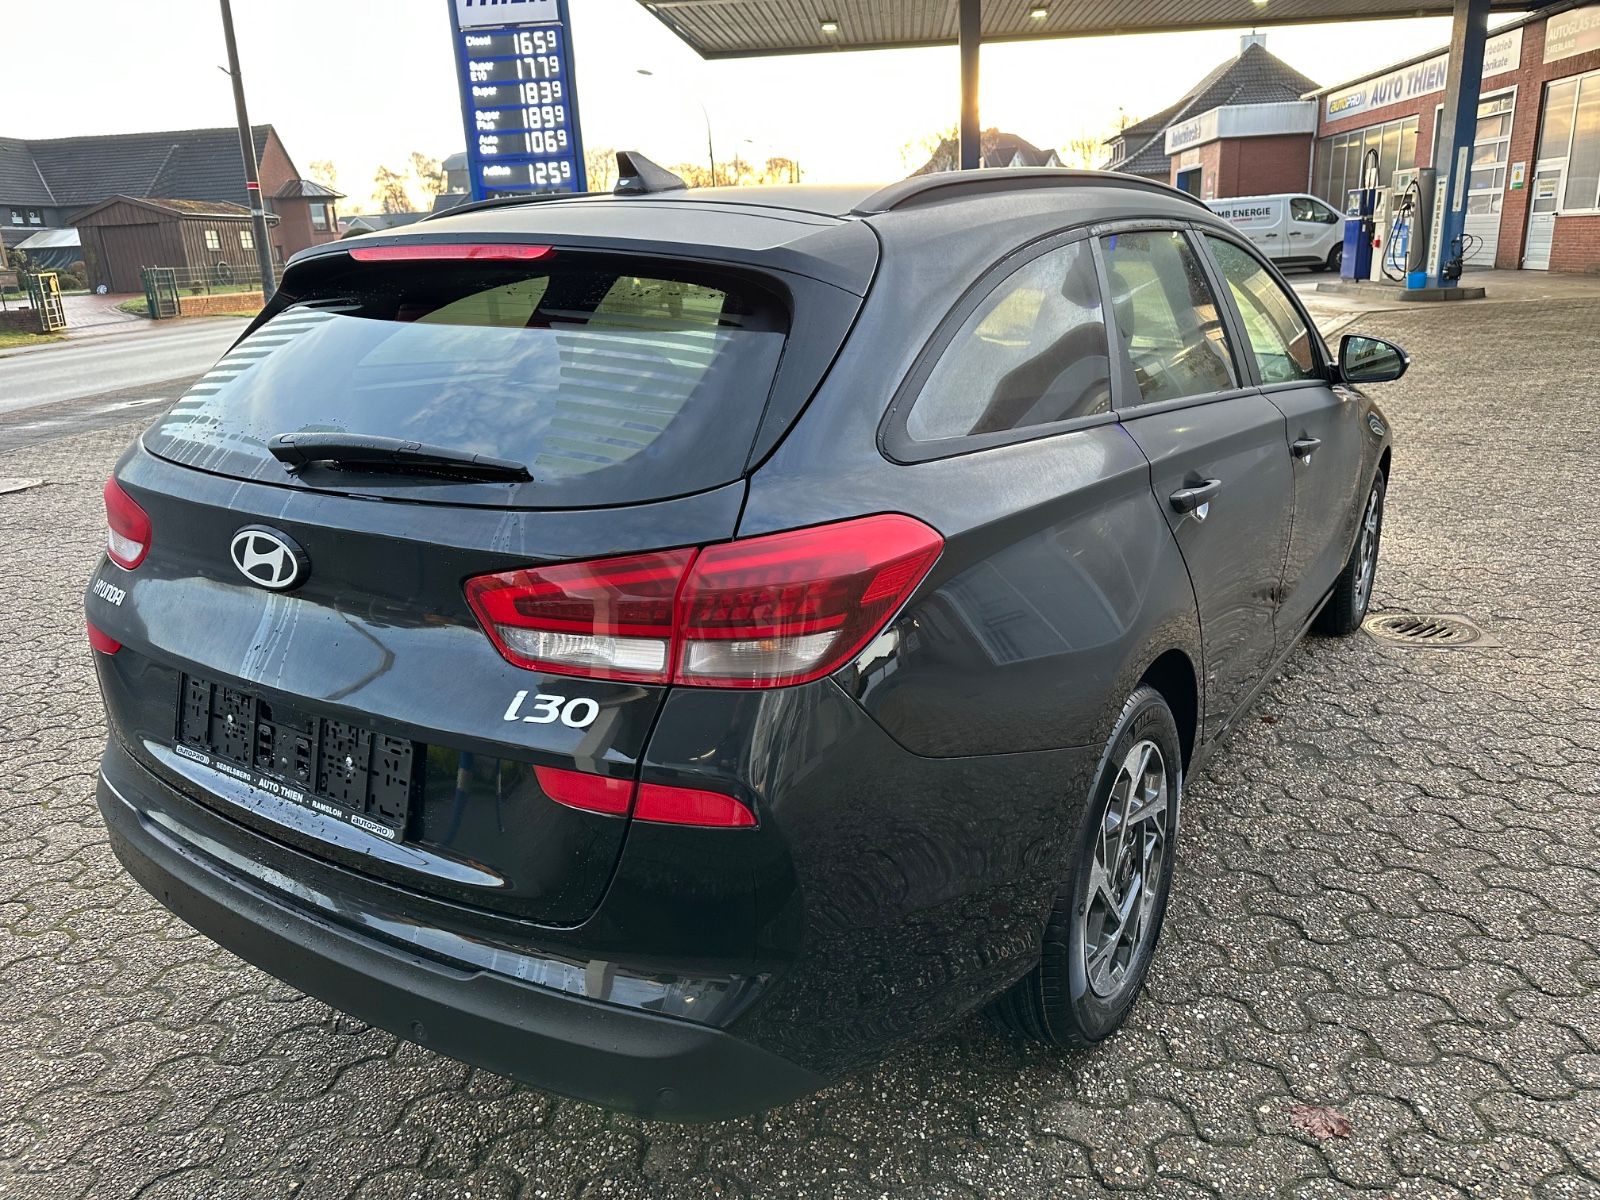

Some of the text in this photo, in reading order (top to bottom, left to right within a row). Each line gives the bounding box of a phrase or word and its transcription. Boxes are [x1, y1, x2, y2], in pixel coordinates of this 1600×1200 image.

[513, 30, 557, 54] 1659
[470, 71, 488, 82] E10
[516, 55, 559, 80] 1779
[519, 80, 562, 105] 1839
[1371, 75, 1403, 106] AUTO
[1406, 60, 1447, 96] THIEN
[522, 105, 564, 129] 1899
[524, 129, 567, 153] 1069
[528, 160, 571, 184] 1259
[1233, 207, 1271, 218] ENERGIE
[93, 579, 127, 606] HYUNDAI
[504, 690, 599, 728] i30
[216, 762, 251, 781] SEDELSBERG
[258, 778, 279, 793] AUTO
[280, 786, 304, 803] THIEN
[312, 800, 342, 818] RAMSLOH
